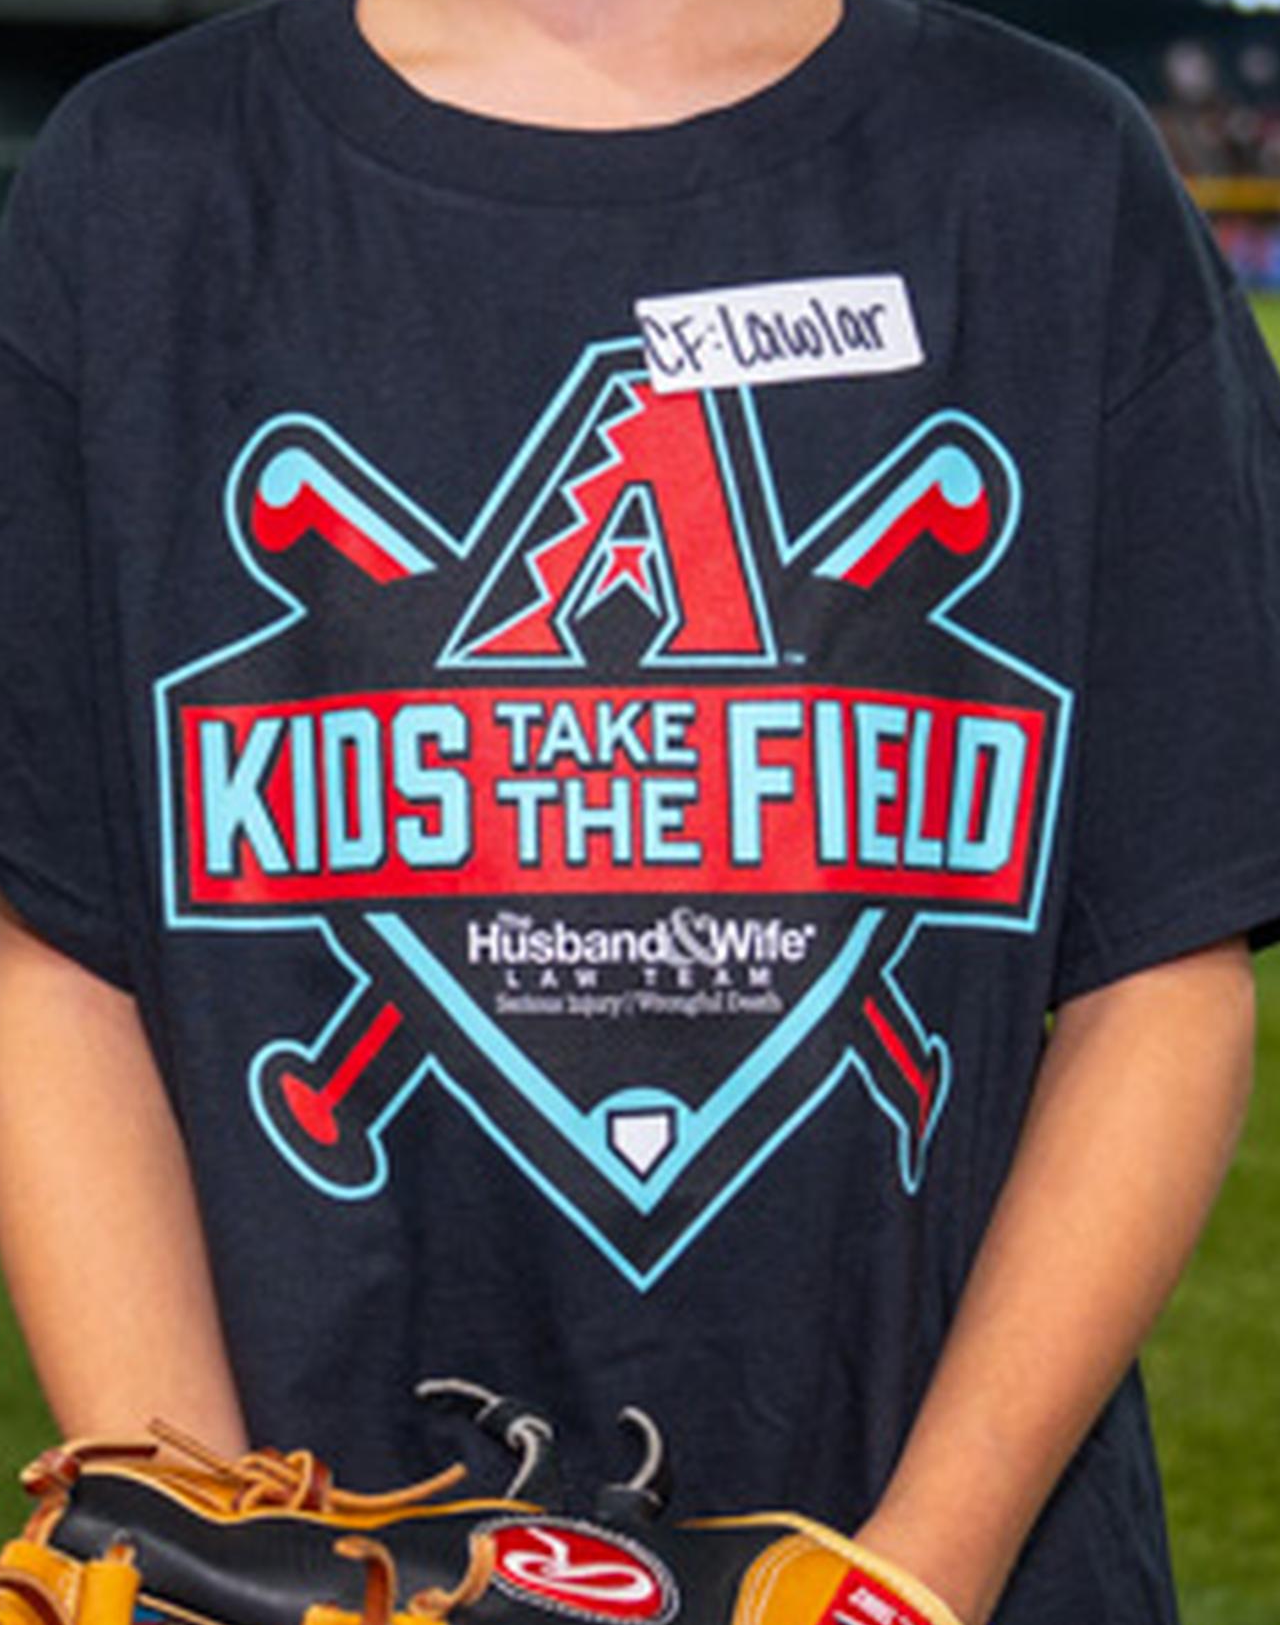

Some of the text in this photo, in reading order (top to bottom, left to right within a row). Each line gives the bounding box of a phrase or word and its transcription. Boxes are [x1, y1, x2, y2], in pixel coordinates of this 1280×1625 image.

[495, 700, 698, 769] TAKE
[199, 702, 473, 876] KIDS
[495, 776, 702, 868] THE
[726, 700, 1030, 874] FIELD
[506, 968, 773, 989] LAW TEAM
